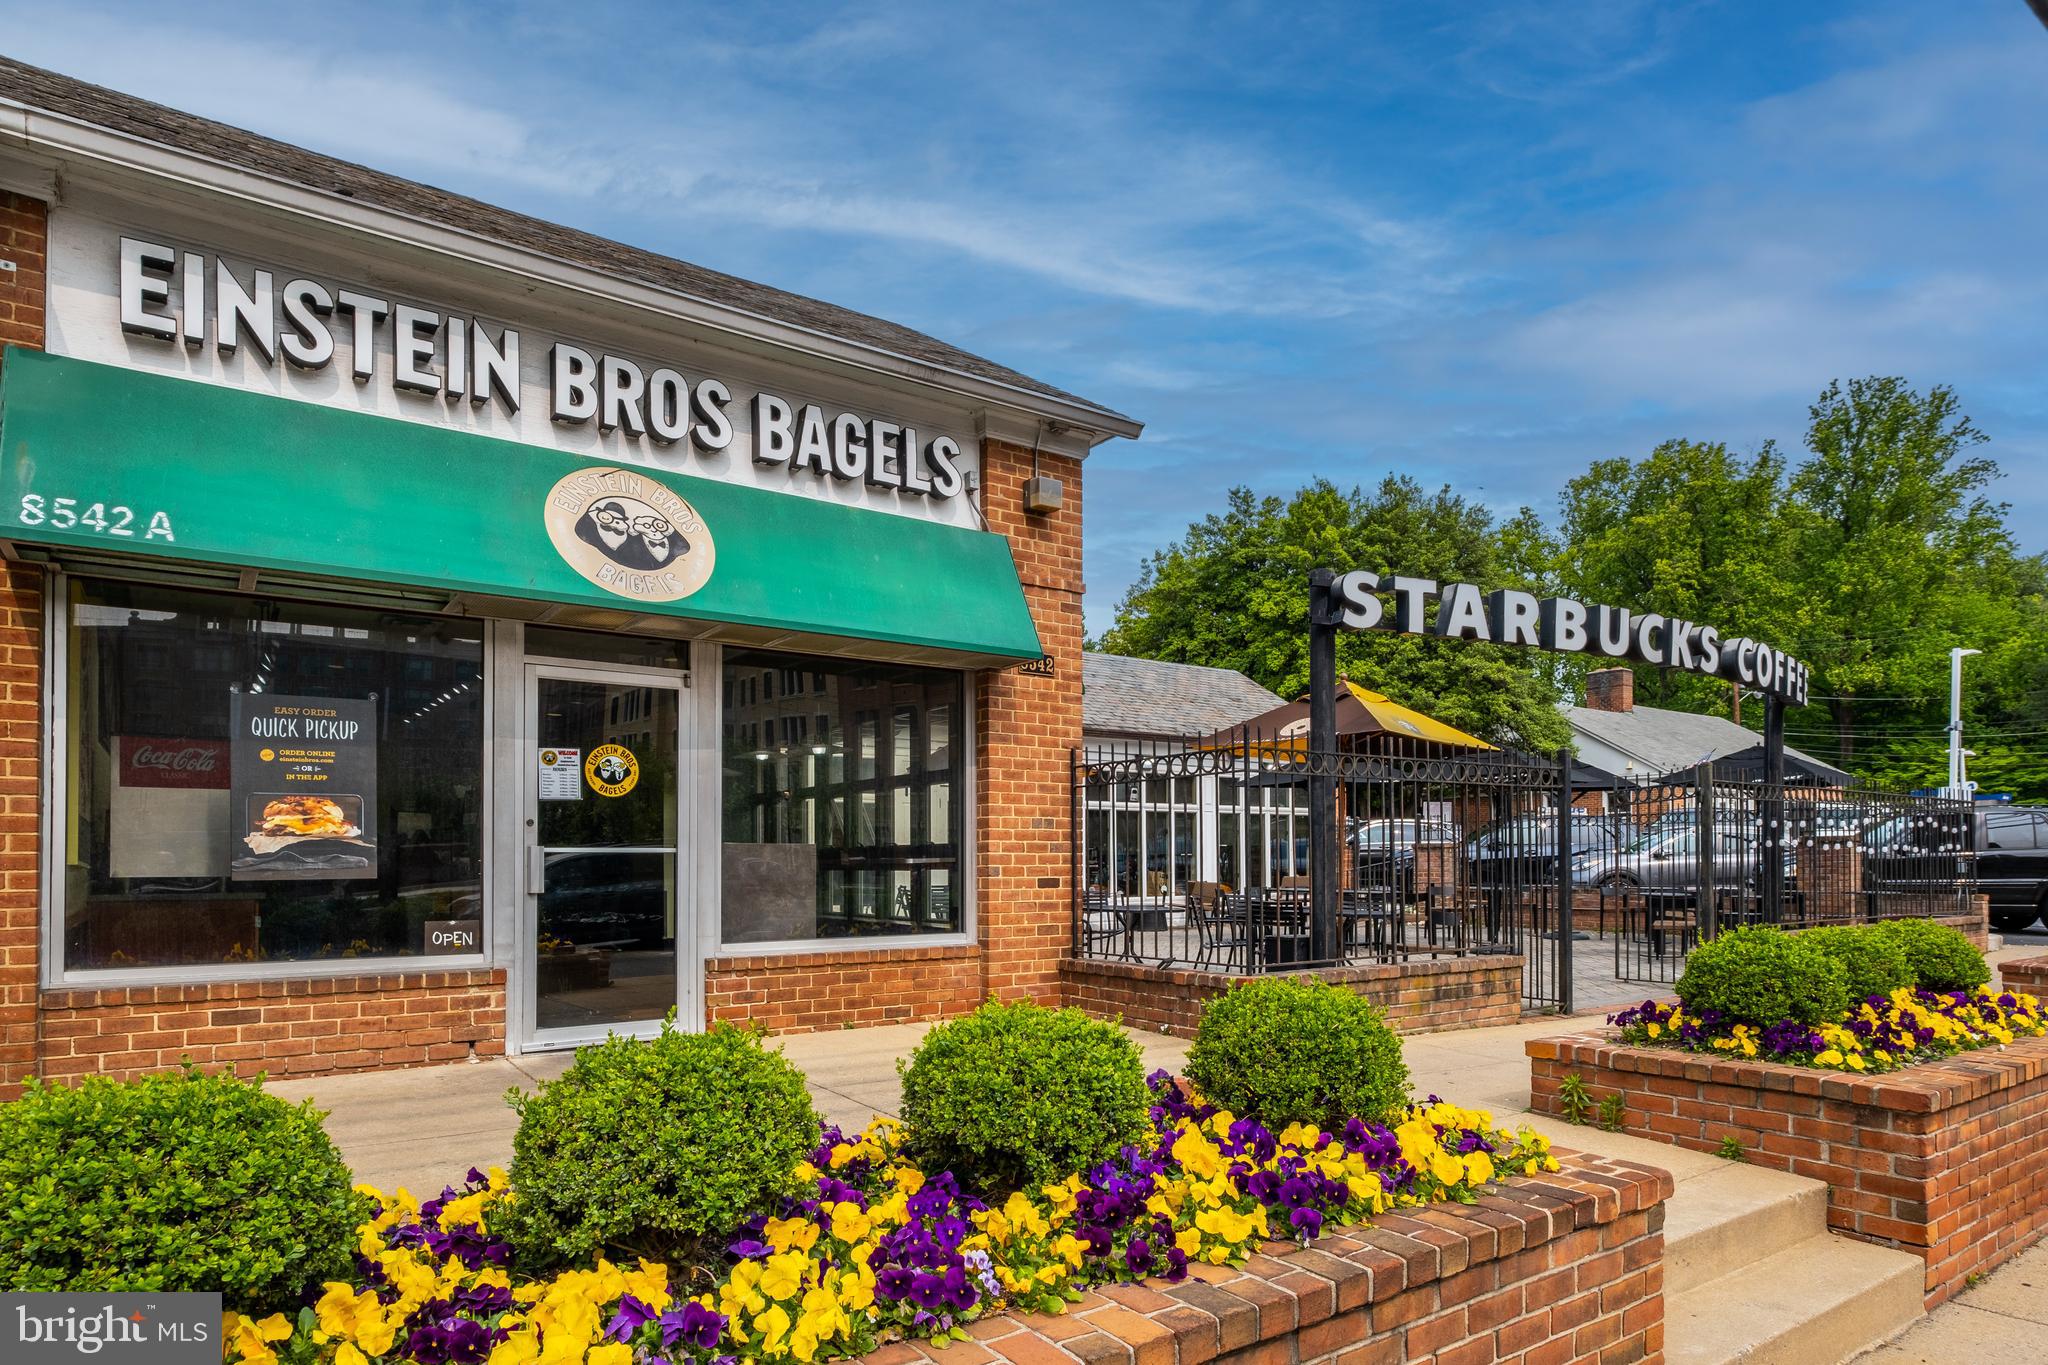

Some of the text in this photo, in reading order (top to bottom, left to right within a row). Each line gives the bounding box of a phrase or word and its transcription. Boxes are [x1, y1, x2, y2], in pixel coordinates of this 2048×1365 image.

[120, 235, 962, 500] EINSTEIN BROS BAGELS
[553, 472, 703, 536] EINSTEIN BROS
[1335, 569, 1809, 708] STARBUCKS COFFEE
[274, 706, 337, 718] EASY ORDER
[251, 716, 359, 740] QUICK PICKUP
[132, 745, 218, 771] Coca-Cola
[588, 746, 637, 768] EINSTEIN BROS
[599, 784, 627, 795] BAGELS
[432, 931, 473, 946] OPEN
